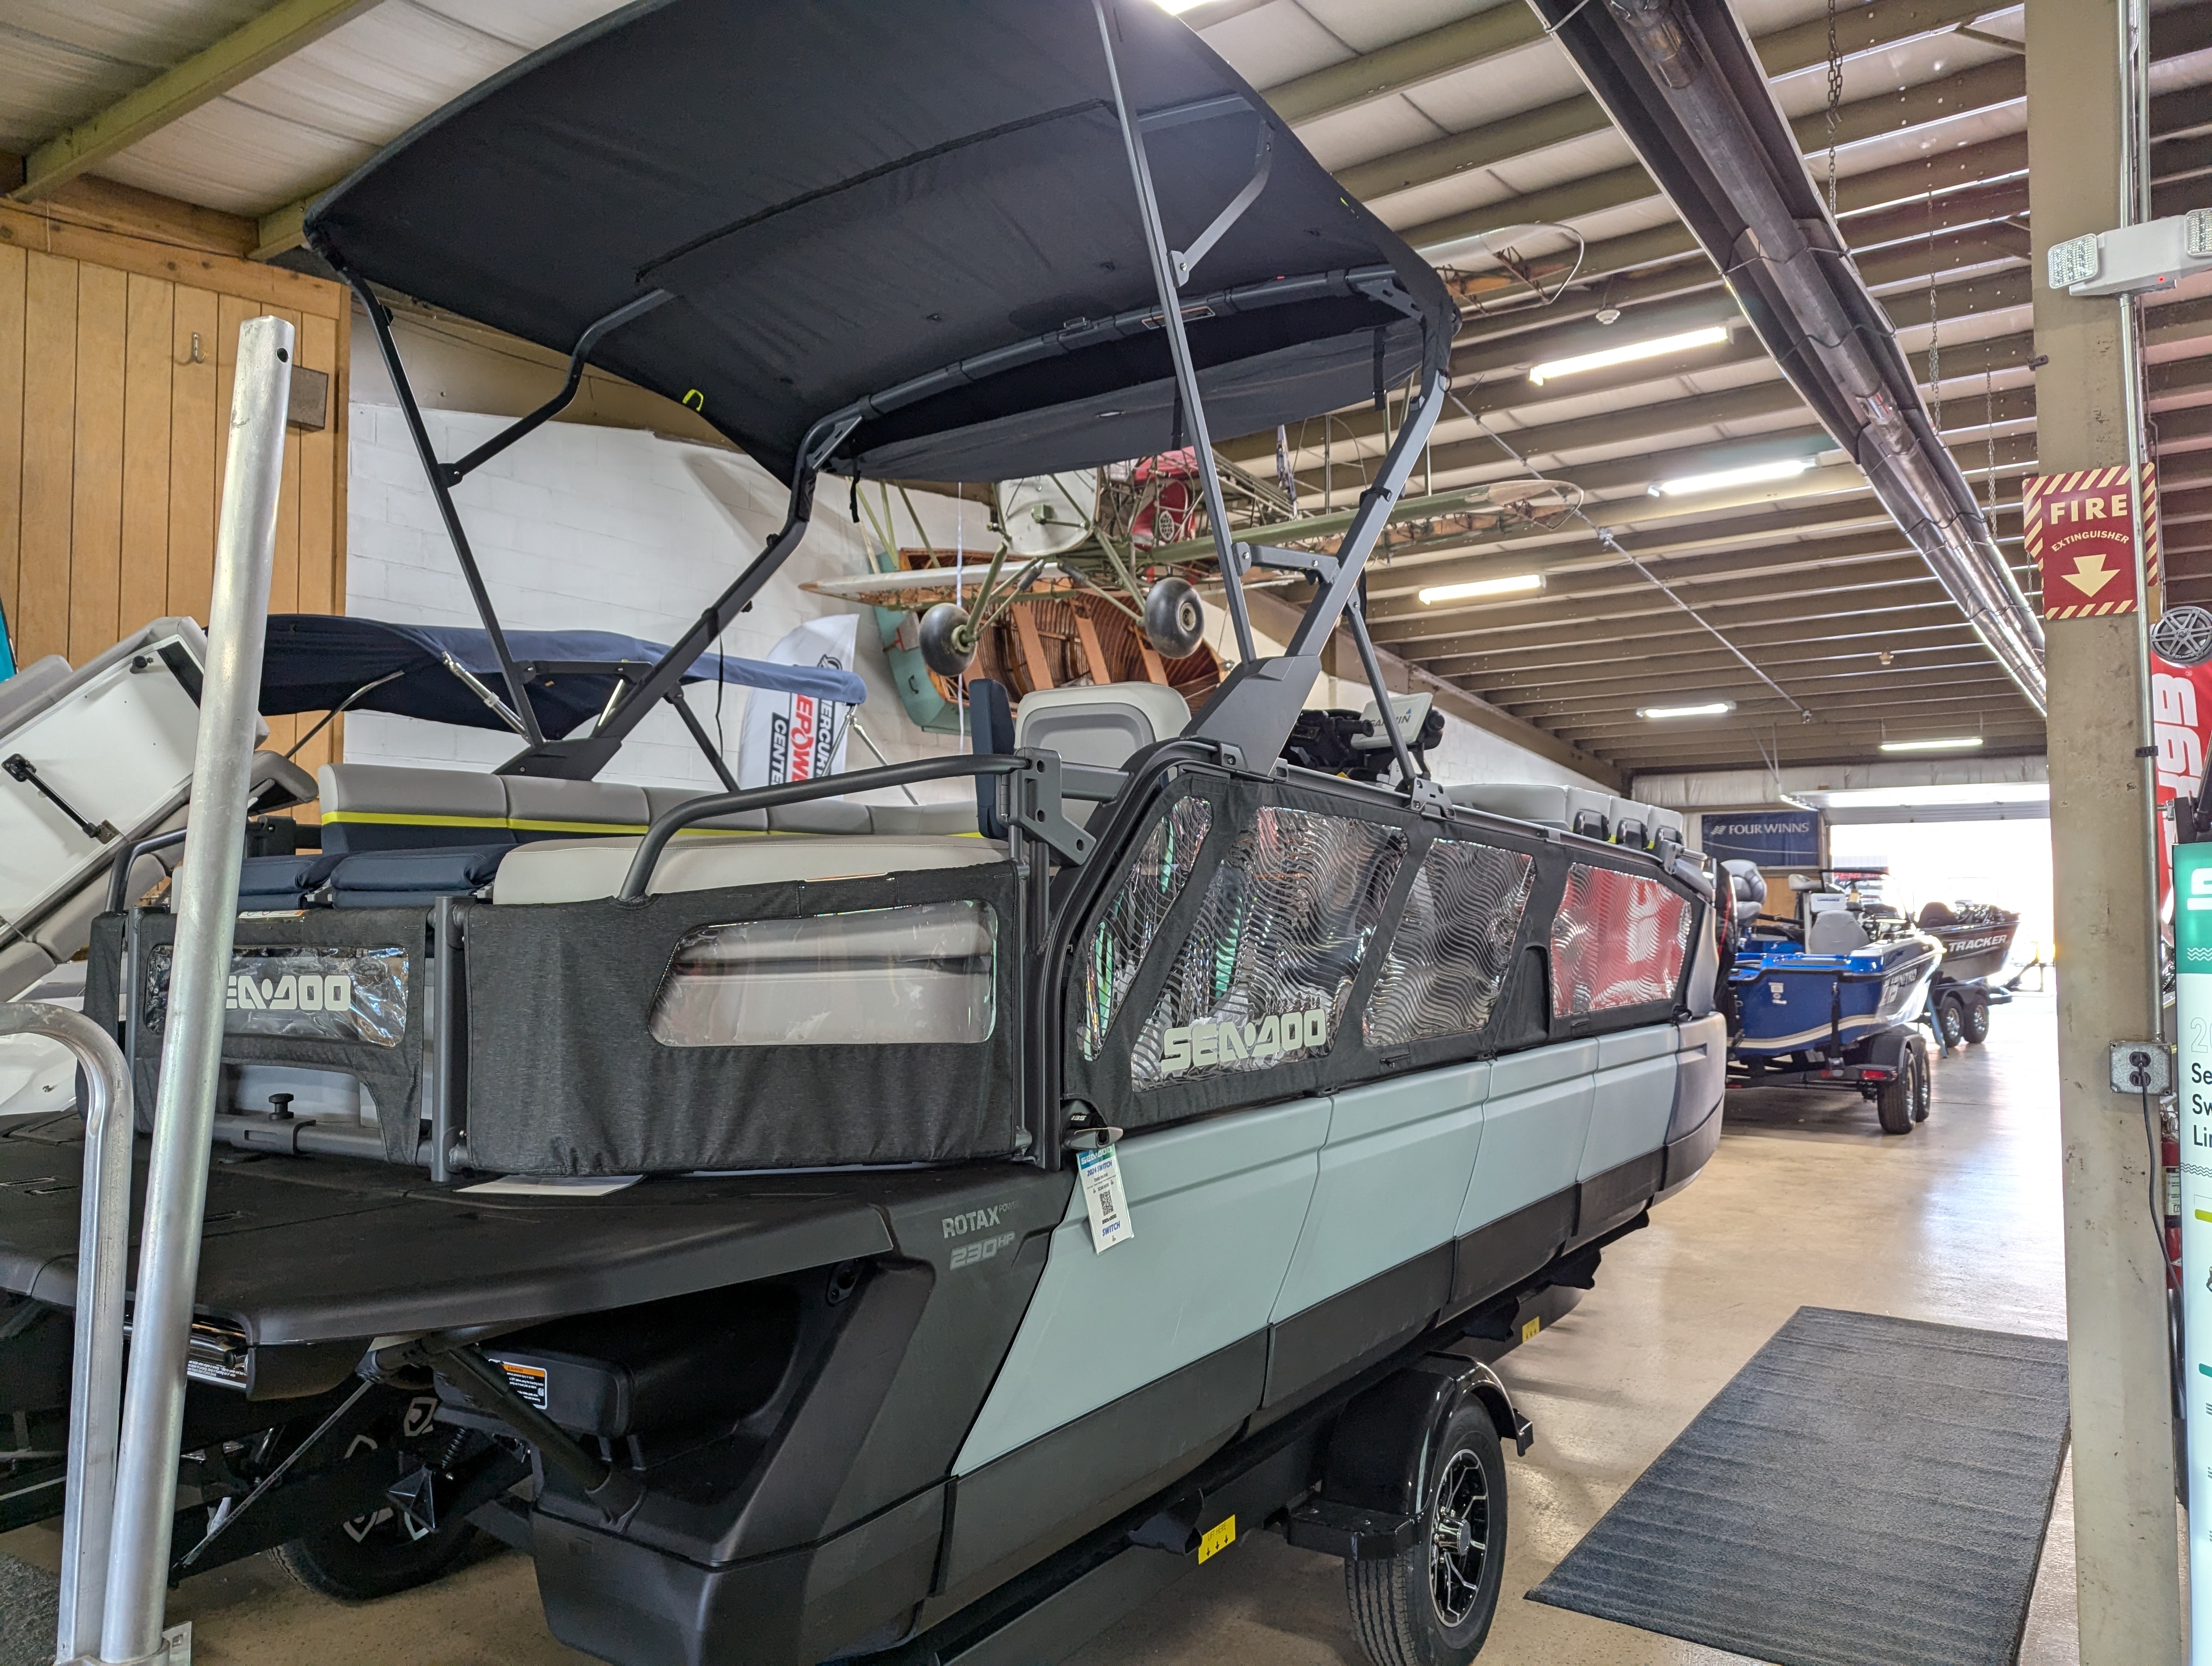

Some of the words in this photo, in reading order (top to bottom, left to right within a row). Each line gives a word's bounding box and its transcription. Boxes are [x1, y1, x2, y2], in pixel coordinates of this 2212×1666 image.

[2050, 494, 2128, 525] FIRE
[2051, 530, 2130, 552] EXTINGUISHER
[1370, 715, 1411, 727] GAIN
[771, 719, 787, 785] CENTE
[1729, 824, 1762, 835] FOUR
[1764, 822, 1810, 834] WINNS
[1949, 934, 2008, 952] TRACKER
[2194, 1124, 2212, 1148] Li
[1097, 1160, 1113, 1172] SWITCH
[942, 1205, 1001, 1239] ROTAX
[1102, 1220, 1121, 1236] SWITCH
[1207, 1529, 1216, 1541] LIFT
[1216, 1522, 1226, 1535] HERE
